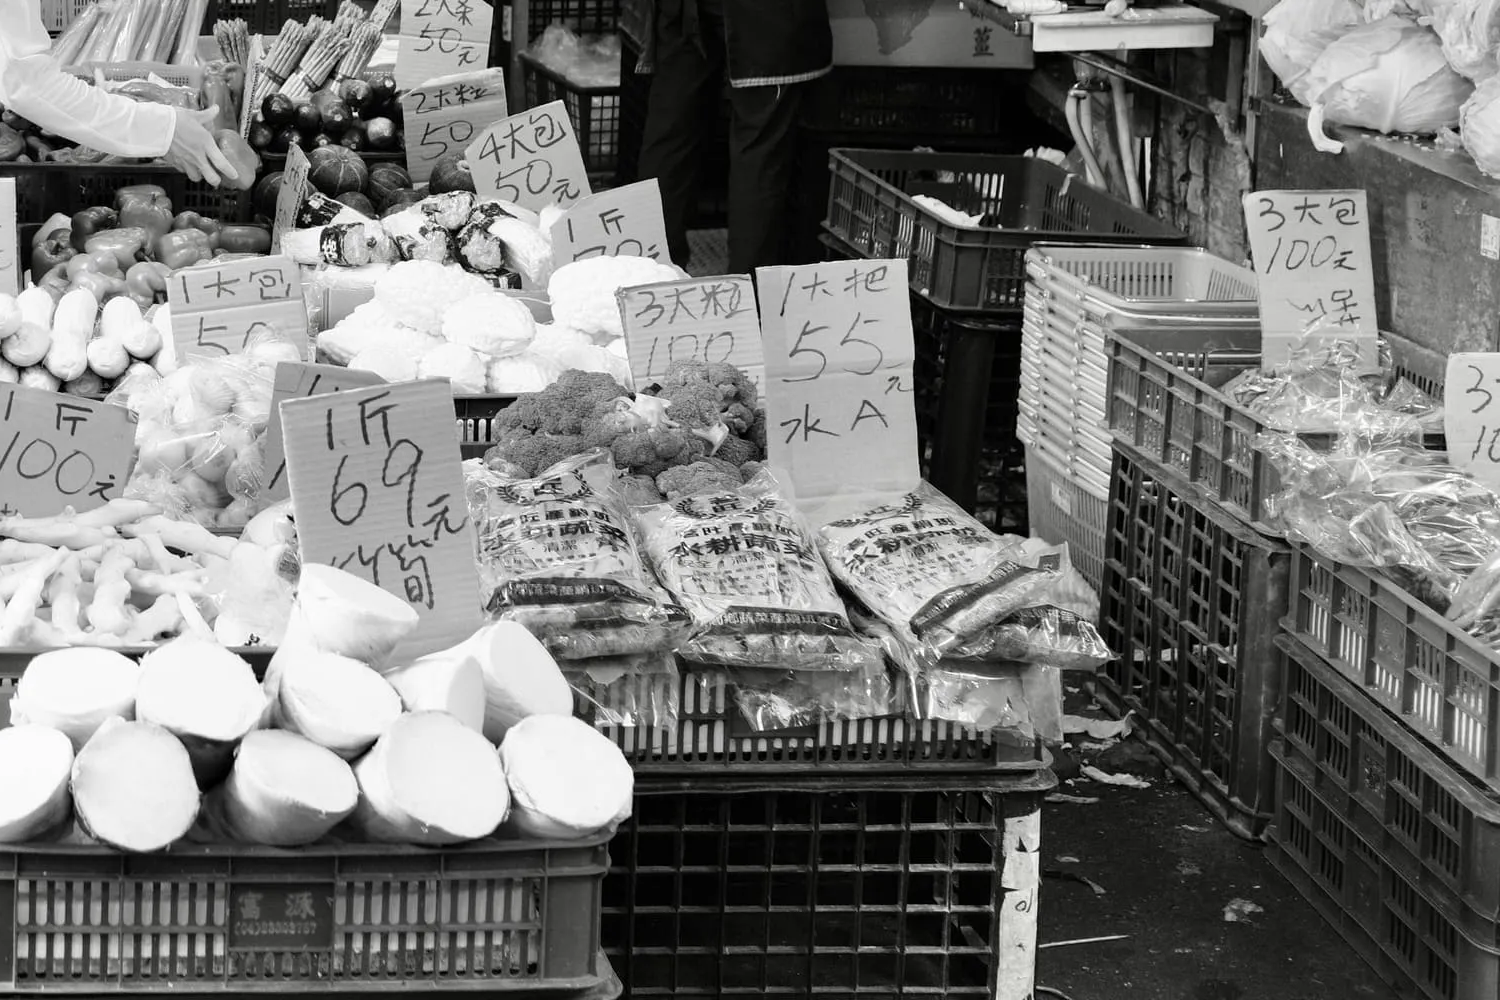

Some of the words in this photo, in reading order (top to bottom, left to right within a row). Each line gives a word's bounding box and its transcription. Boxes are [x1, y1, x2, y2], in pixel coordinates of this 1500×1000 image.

[414, 23, 480, 67] 50元
[411, 83, 494, 114] 2大粒
[421, 121, 474, 160] 50
[479, 113, 567, 164] 4大包
[495, 159, 580, 203] 50元
[568, 208, 625, 243] 1斤
[1259, 197, 1359, 231] 3大包
[1266, 235, 1356, 274] 100元
[635, 283, 755, 328] 3大粒
[780, 265, 888, 317] 1大把
[4, 390, 94, 437] 1斤
[326, 391, 399, 450] 1斤
[330, 438, 468, 541] 69元
